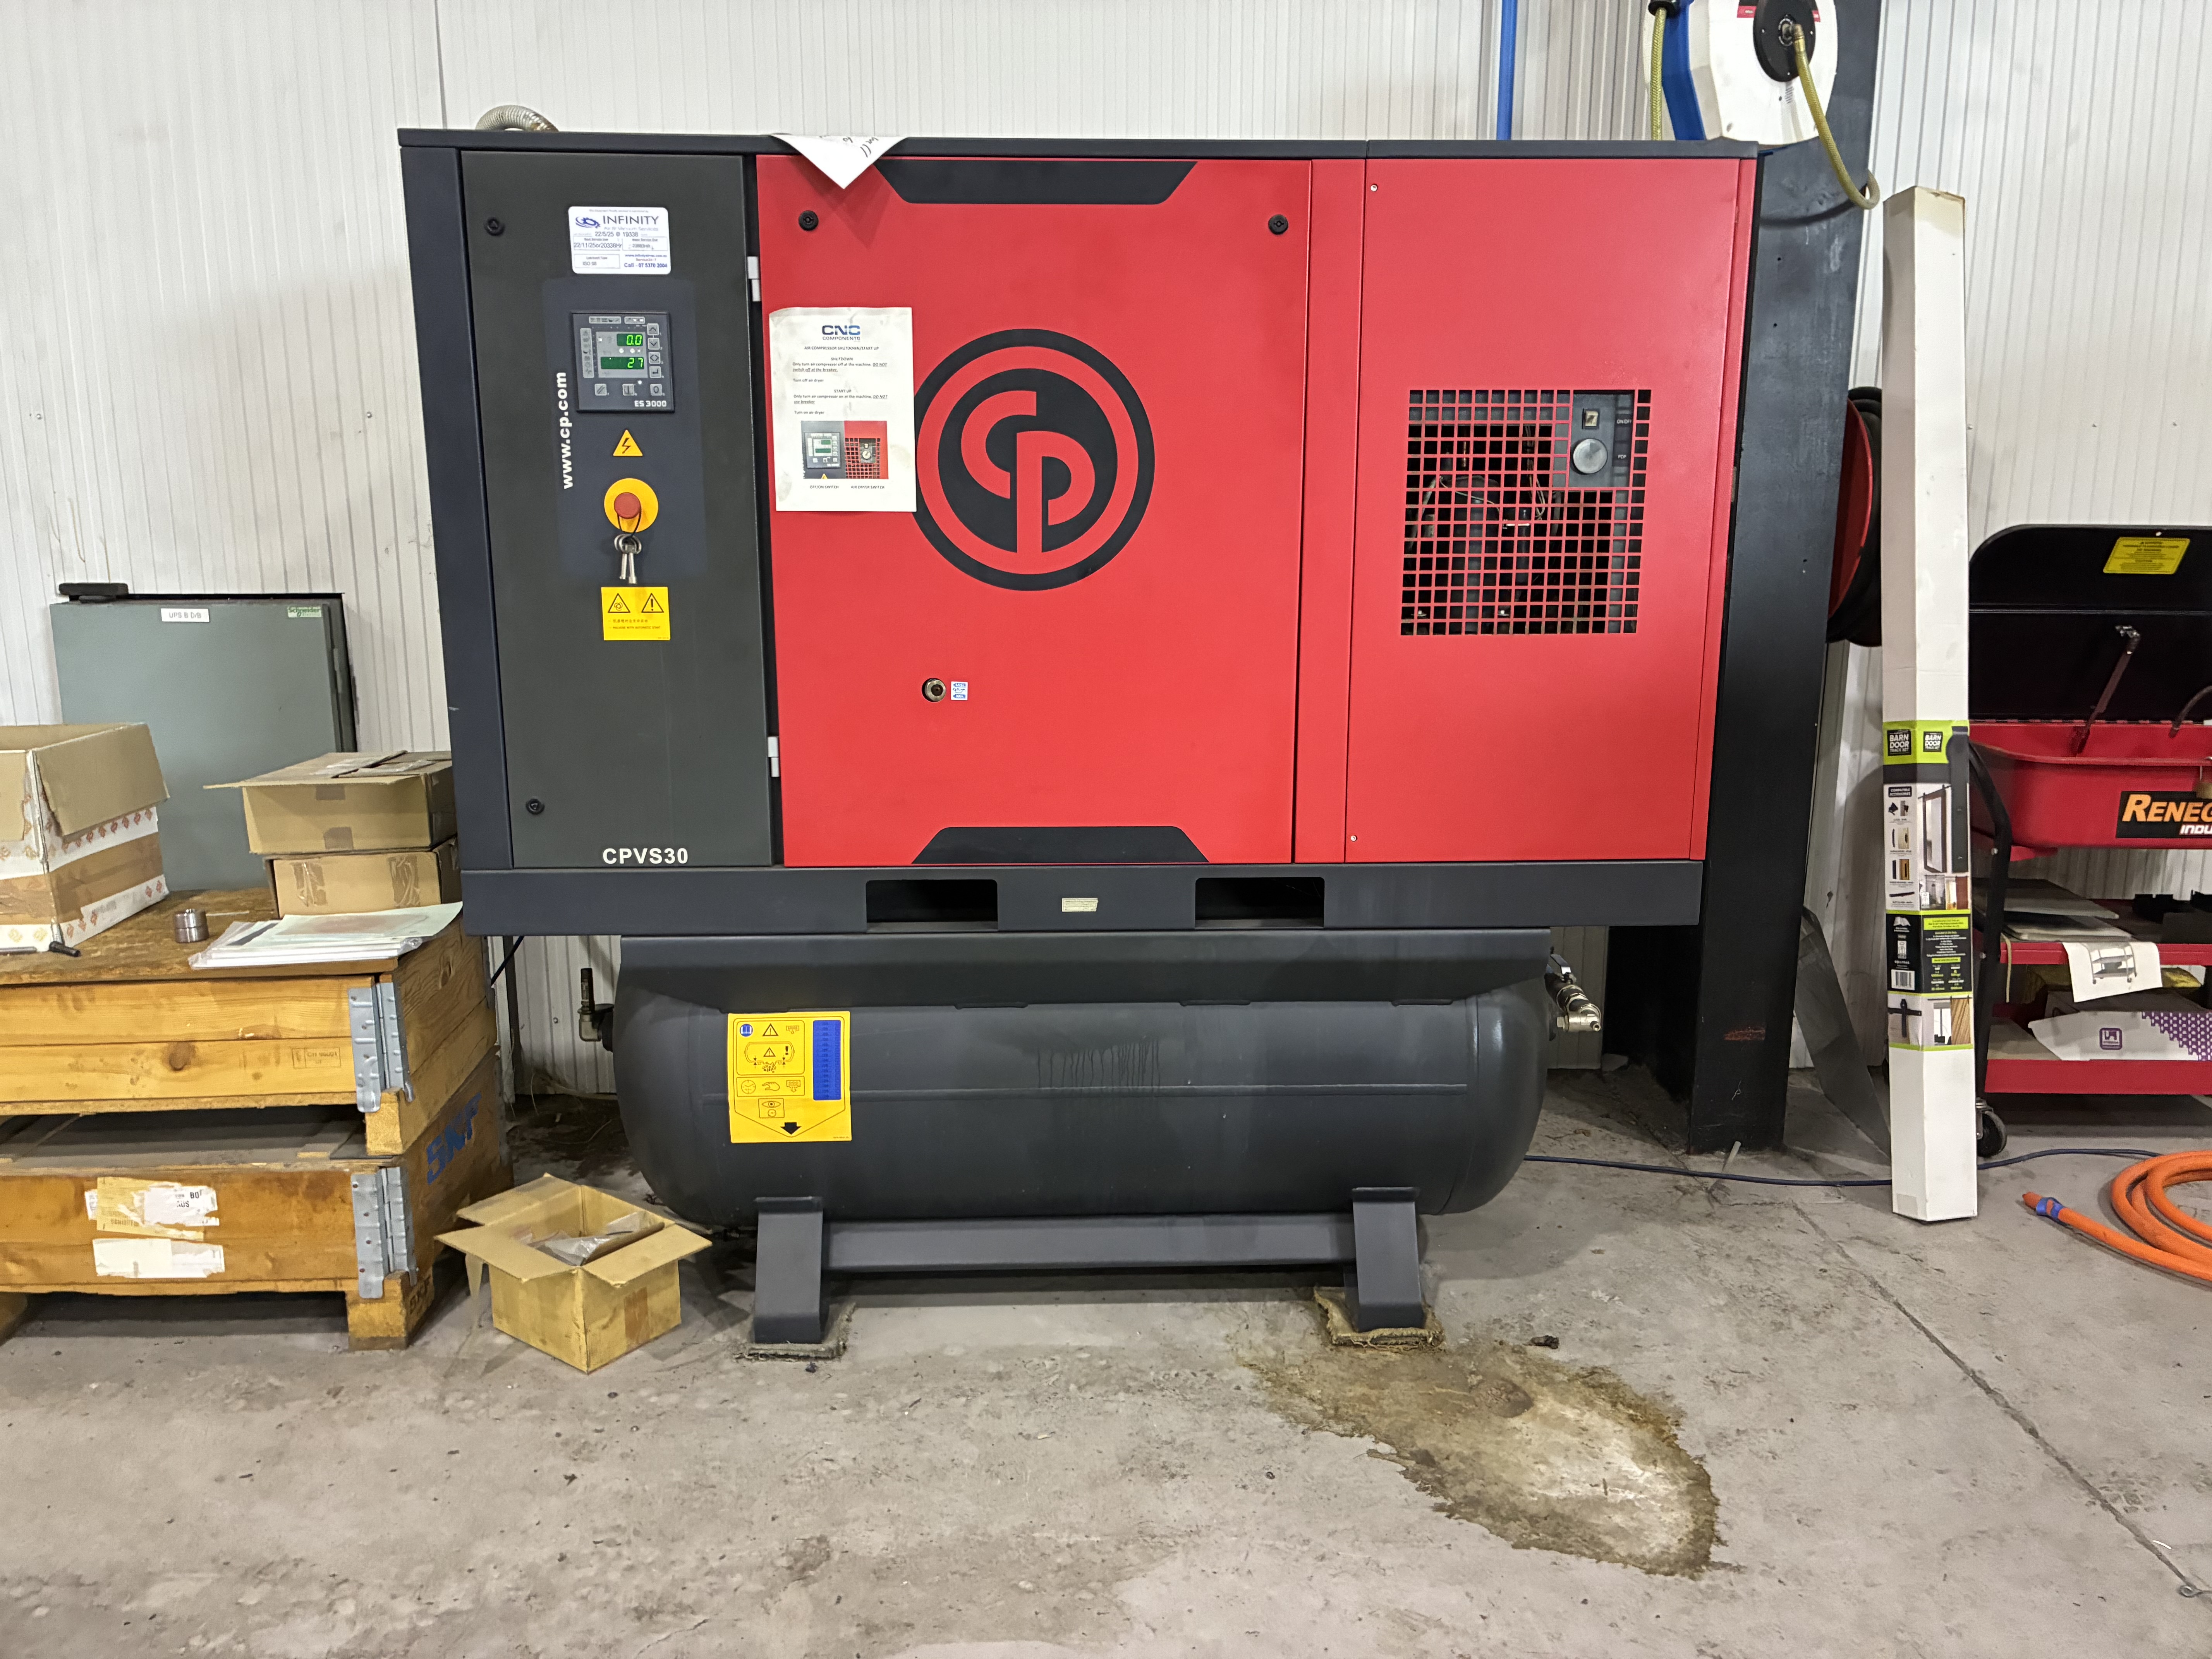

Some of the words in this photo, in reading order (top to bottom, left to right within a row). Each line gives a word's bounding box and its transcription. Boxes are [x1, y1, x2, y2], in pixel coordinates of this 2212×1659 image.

[603, 215, 659, 225] INFINITY
[822, 325, 860, 335] CNC
[627, 357, 643, 368] 27
[556, 372, 573, 489] www.cp.com
[288, 605, 319, 617] Schneider
[1889, 741, 1910, 749] DOOR
[603, 847, 688, 864] CPVS30
[426, 1091, 482, 1186] SKF
